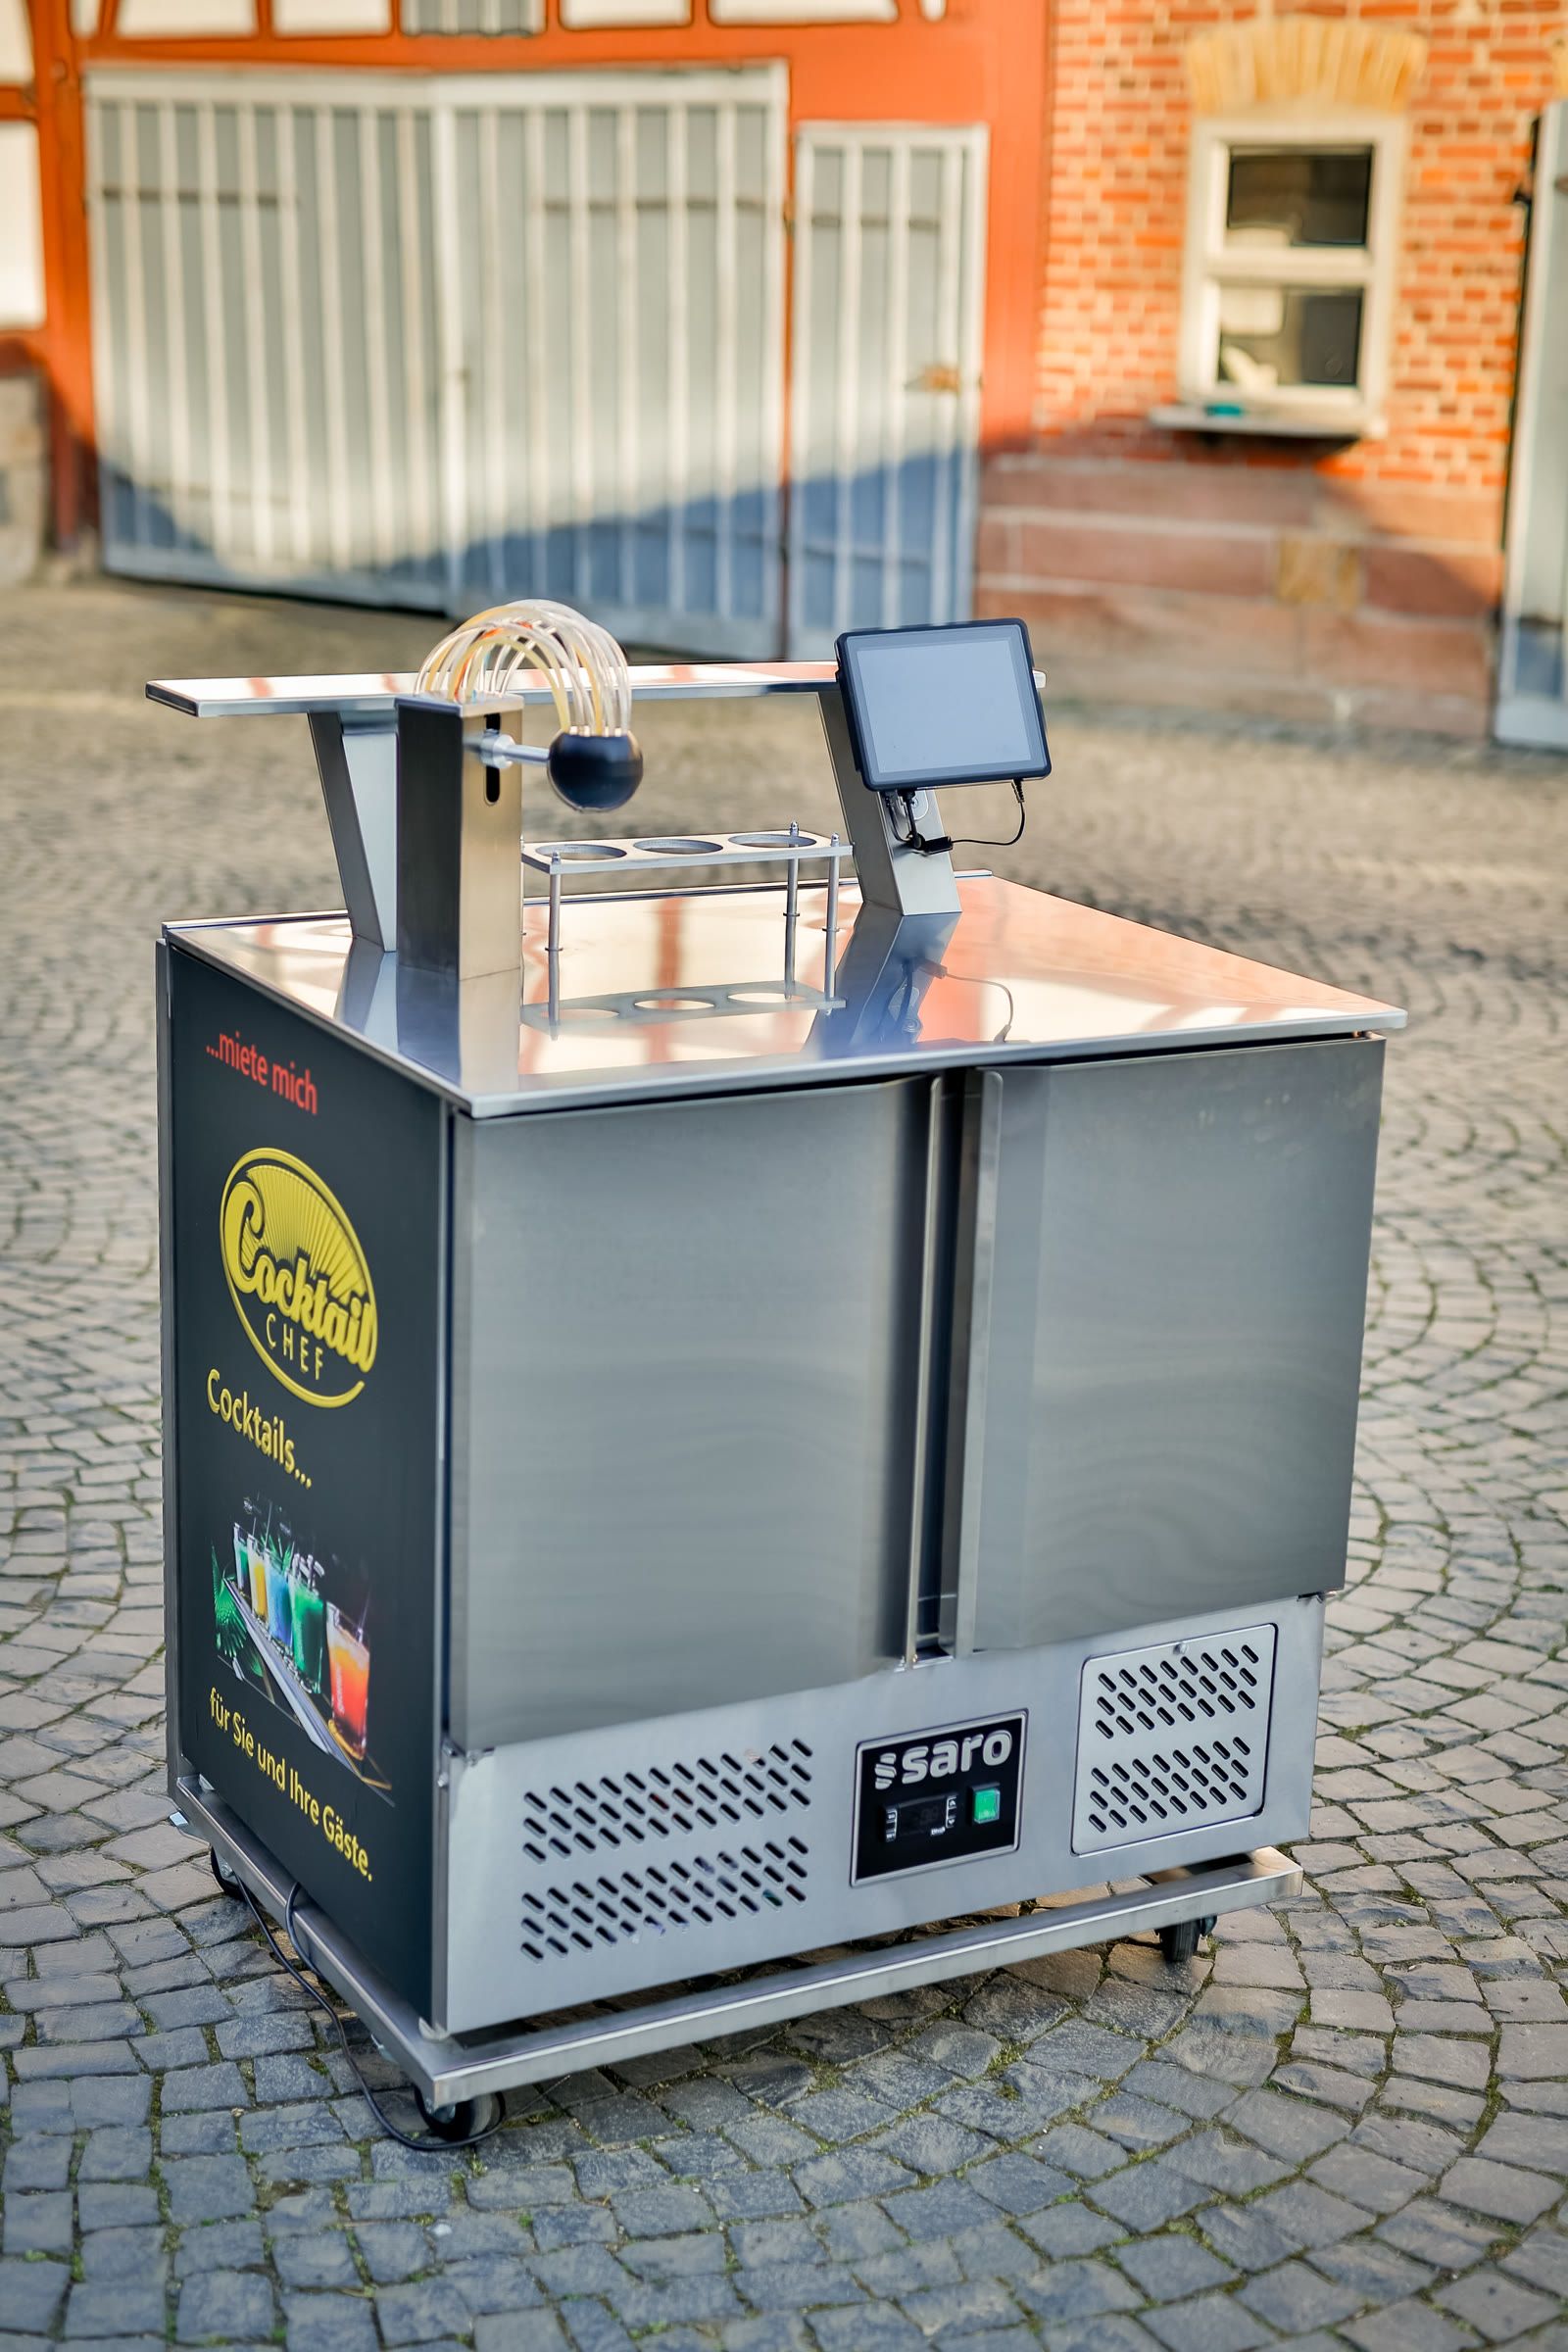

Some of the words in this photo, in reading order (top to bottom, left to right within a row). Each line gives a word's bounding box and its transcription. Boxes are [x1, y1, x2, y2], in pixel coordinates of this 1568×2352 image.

[205, 1030, 268, 1087] ...miete
[272, 1060, 318, 1114] mich
[224, 1180, 378, 1373] Cocktail
[266, 1312, 323, 1380] CHEF
[207, 1368, 312, 1489] Cocktails...
[210, 1687, 230, 1733] für
[232, 1711, 255, 1757] Sie
[257, 1742, 286, 1792] und
[289, 1768, 319, 1826] Ihre
[322, 1805, 373, 1883] Gäste.
[901, 1729, 1012, 1785] saro
